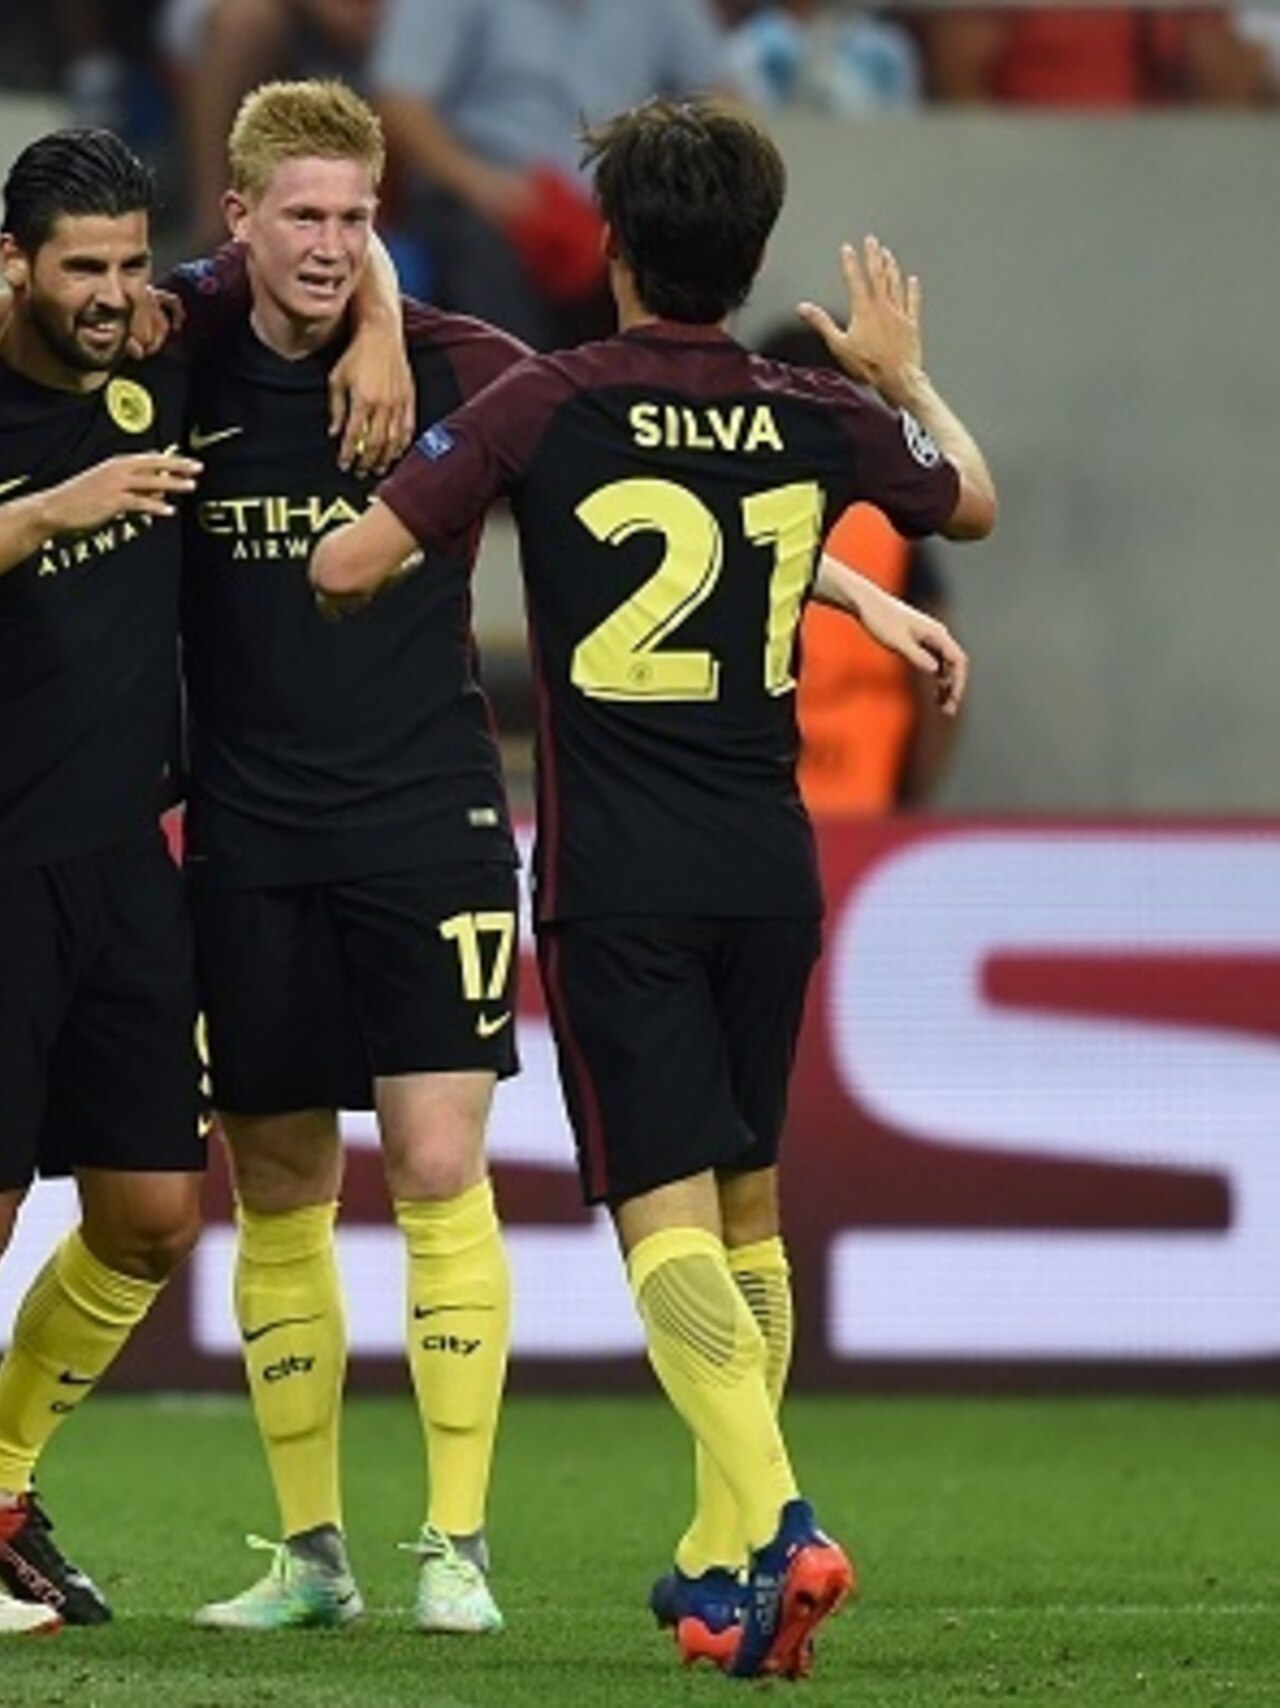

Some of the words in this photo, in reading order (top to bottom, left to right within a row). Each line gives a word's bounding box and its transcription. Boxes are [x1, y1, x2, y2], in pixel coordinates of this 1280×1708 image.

[628, 403, 784, 452] SILVA
[198, 496, 382, 534] ETIHA
[232, 537, 310, 561] AIRW
[570, 477, 826, 700] 21
[437, 911, 516, 1001] 17
[420, 1334, 481, 1357] city
[262, 1353, 317, 1383] city
